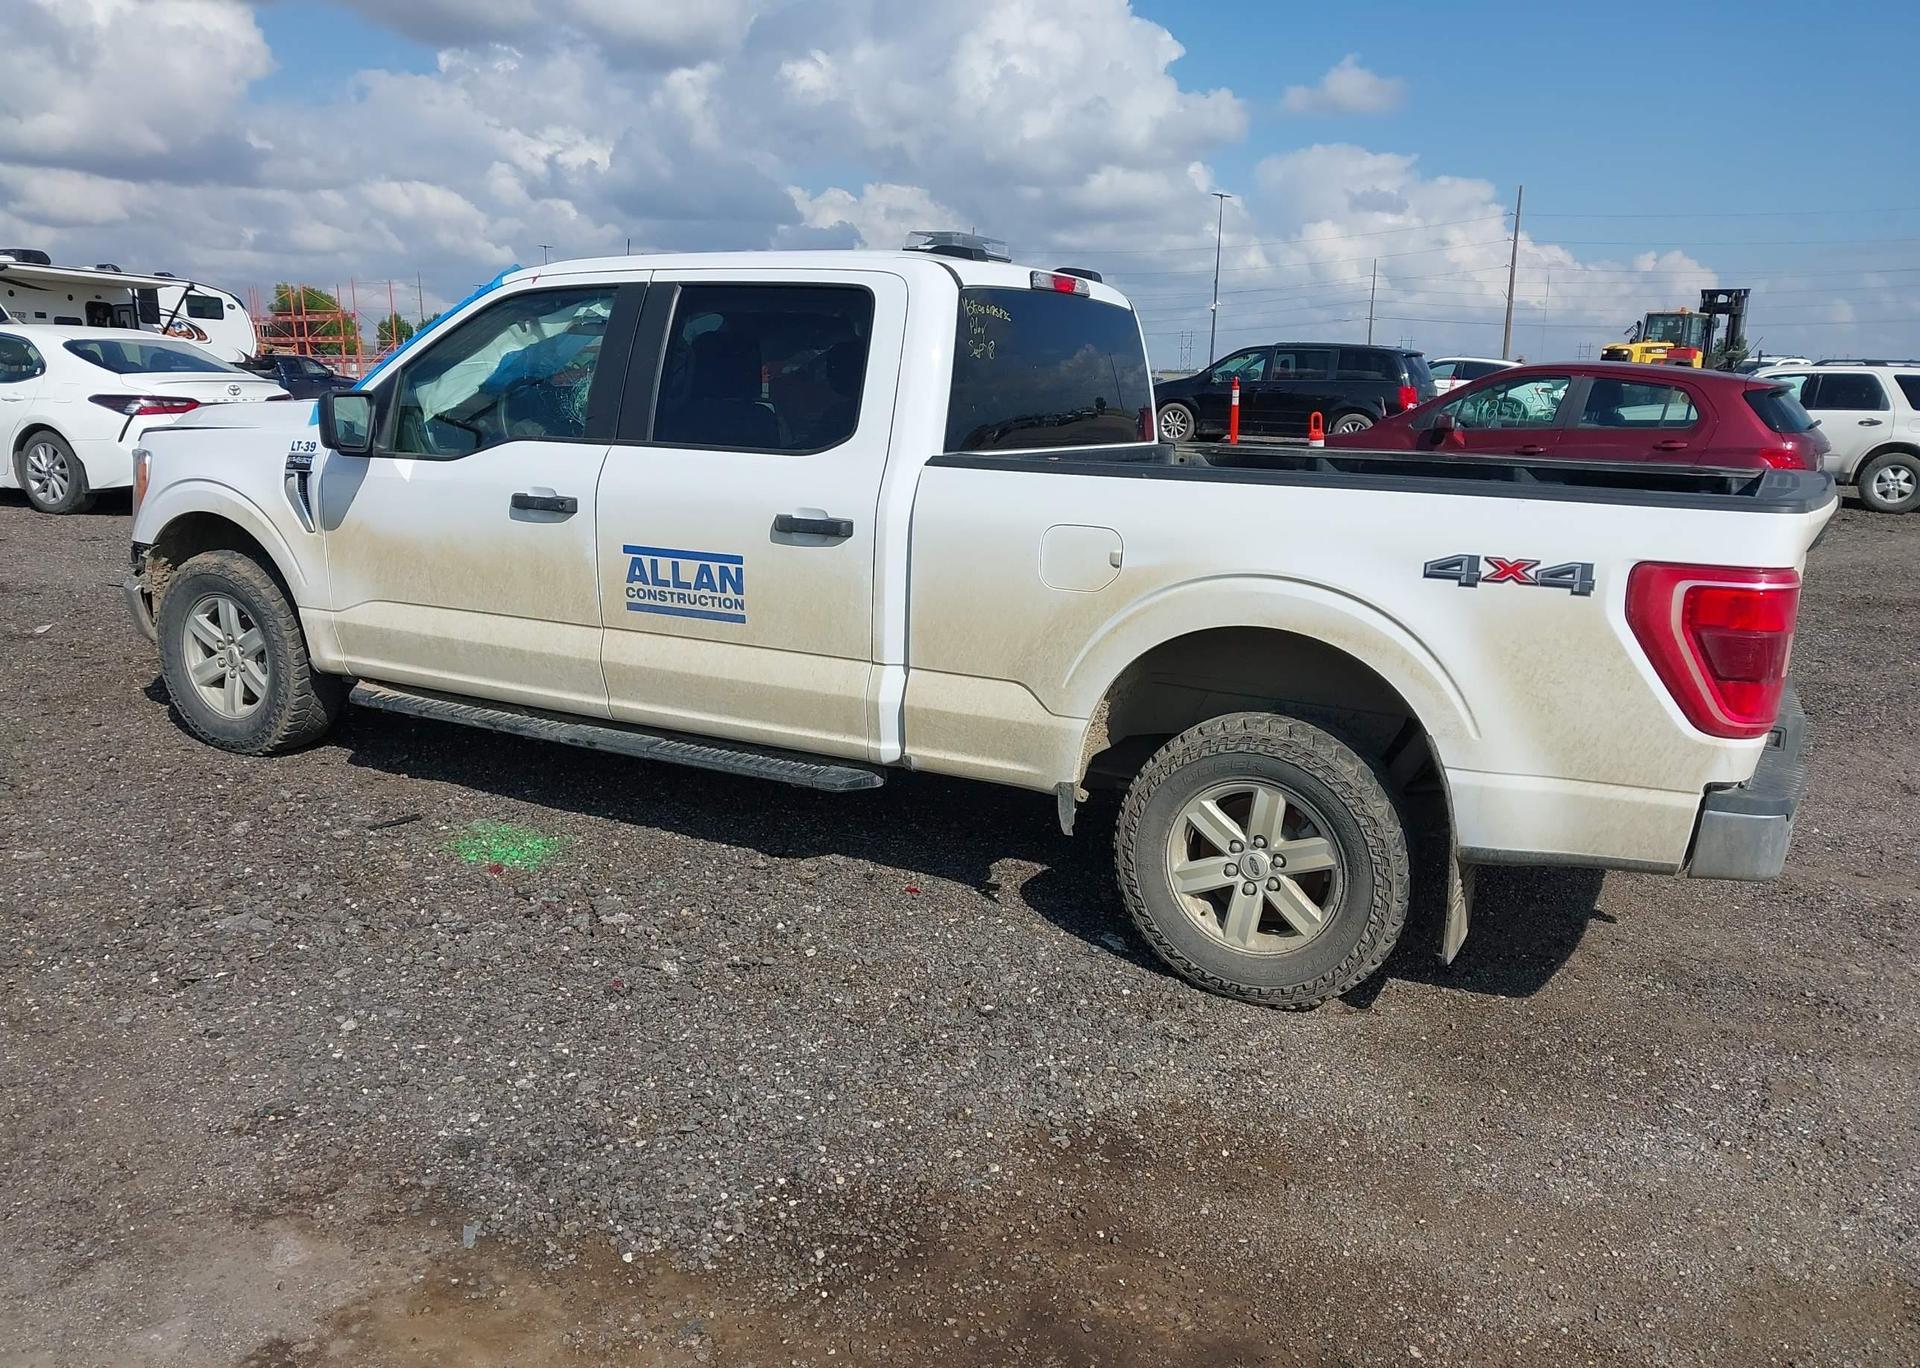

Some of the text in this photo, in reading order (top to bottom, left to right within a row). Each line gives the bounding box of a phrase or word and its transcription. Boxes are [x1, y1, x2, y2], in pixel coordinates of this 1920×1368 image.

[290, 440, 317, 453] LT-39
[625, 556, 744, 596] ALLAN
[1422, 553, 1596, 597] 4X4
[625, 586, 745, 611] CONSTRUCTION
